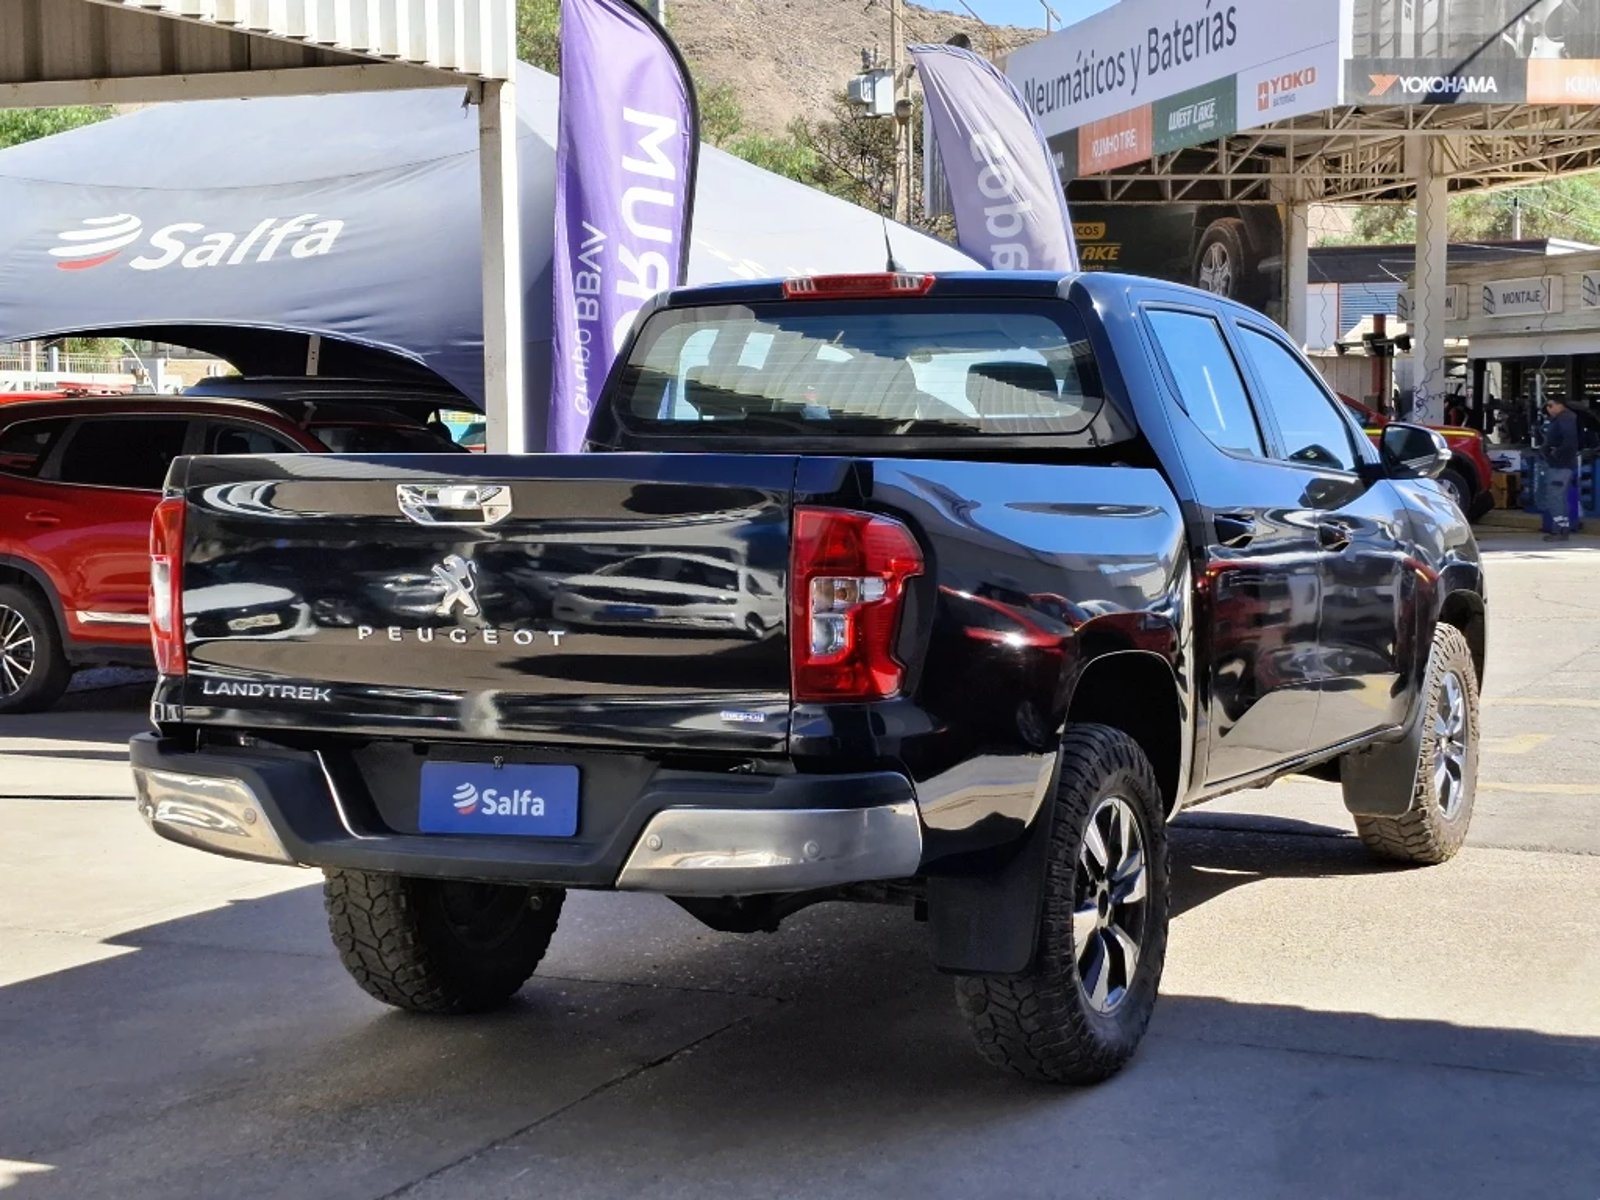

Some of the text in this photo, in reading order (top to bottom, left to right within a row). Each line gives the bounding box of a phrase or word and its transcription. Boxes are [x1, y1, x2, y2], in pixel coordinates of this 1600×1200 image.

[1024, 0, 1237, 116] Neumáticos y Baterías
[1270, 66, 1316, 94] YOKO
[1400, 76, 1498, 93] YOKOHAMA
[1168, 98, 1216, 131] WEST LAKE
[129, 213, 345, 271] Salfa
[1502, 290, 1541, 305] MONTAJE
[357, 625, 567, 647] PEUGEOT
[202, 680, 332, 702] LANDTREK
[481, 788, 546, 817] Salfa
